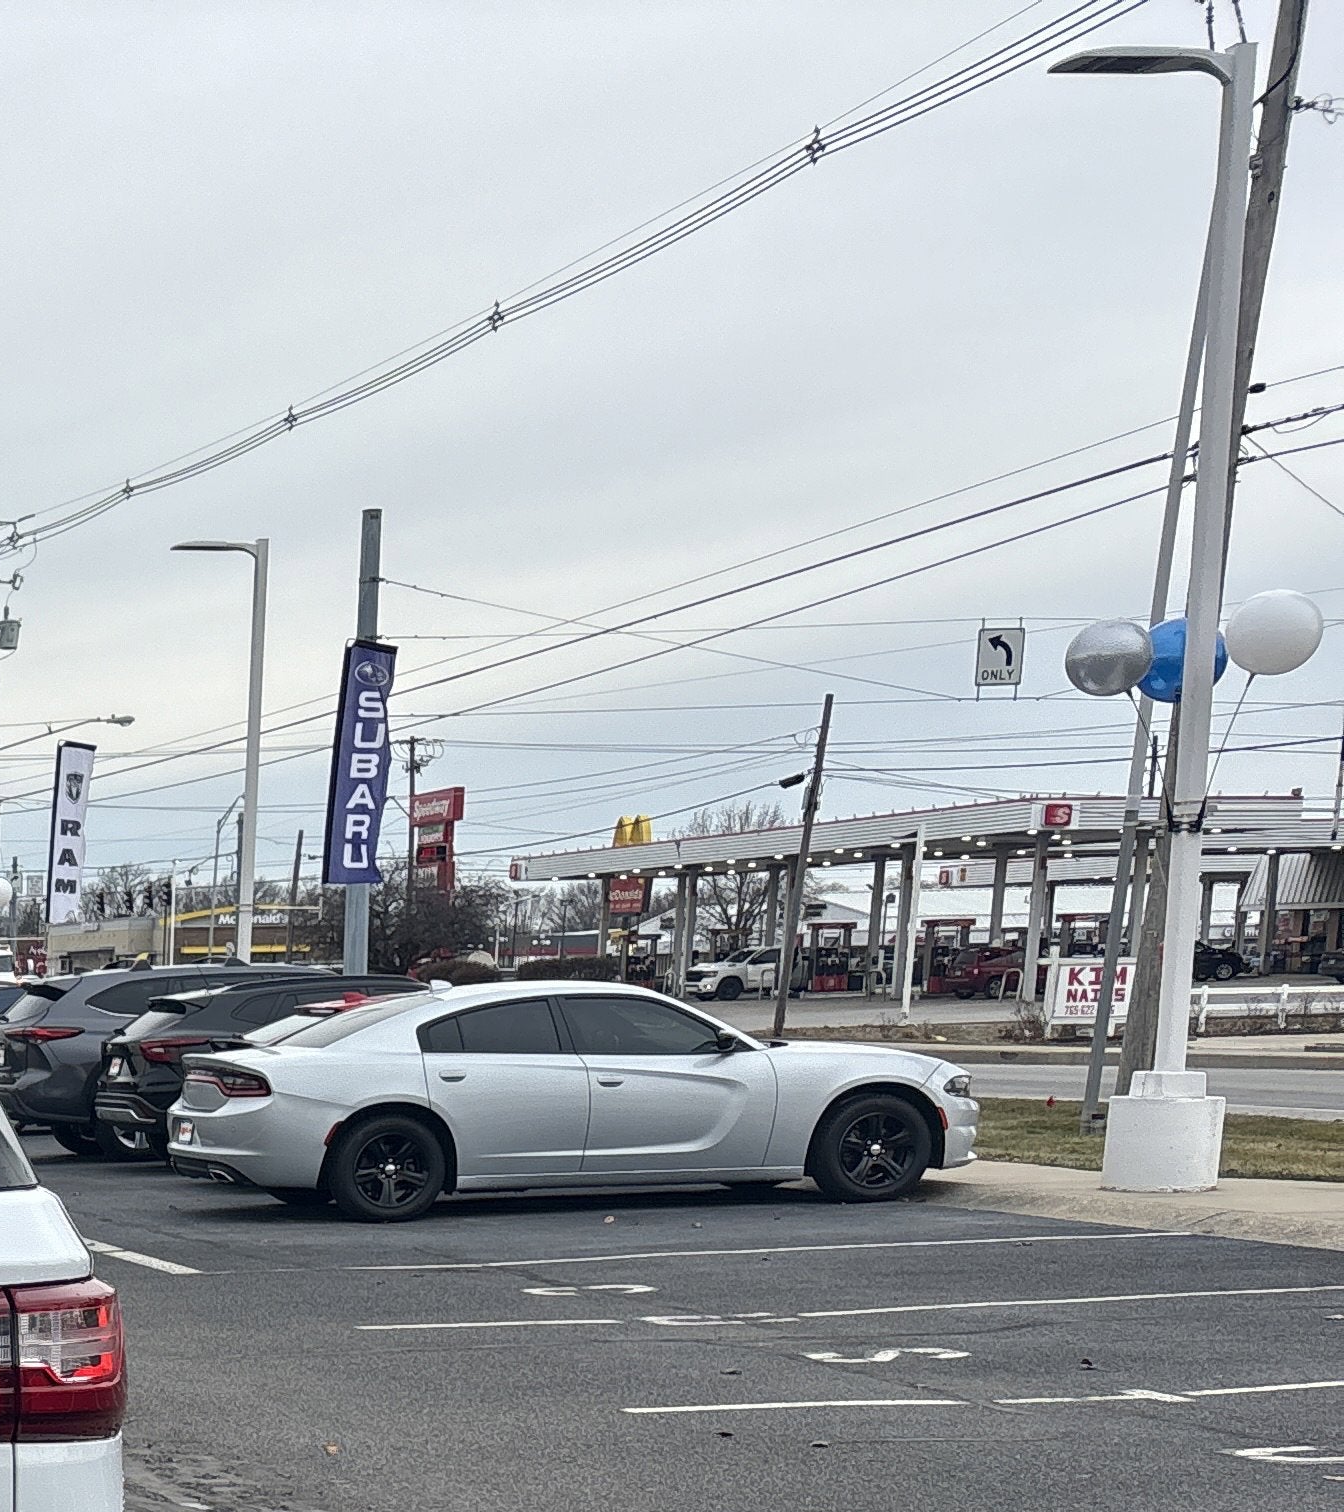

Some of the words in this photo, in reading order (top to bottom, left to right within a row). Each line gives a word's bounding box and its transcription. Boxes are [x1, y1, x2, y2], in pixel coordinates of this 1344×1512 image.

[981, 669, 1015, 681] ONLY
[342, 690, 386, 869] SUBARU
[54, 818, 82, 895] RAM
[218, 912, 289, 925] Mcnald's
[1067, 966, 1128, 987] KIM
[1066, 987, 1126, 1003] NAIS
